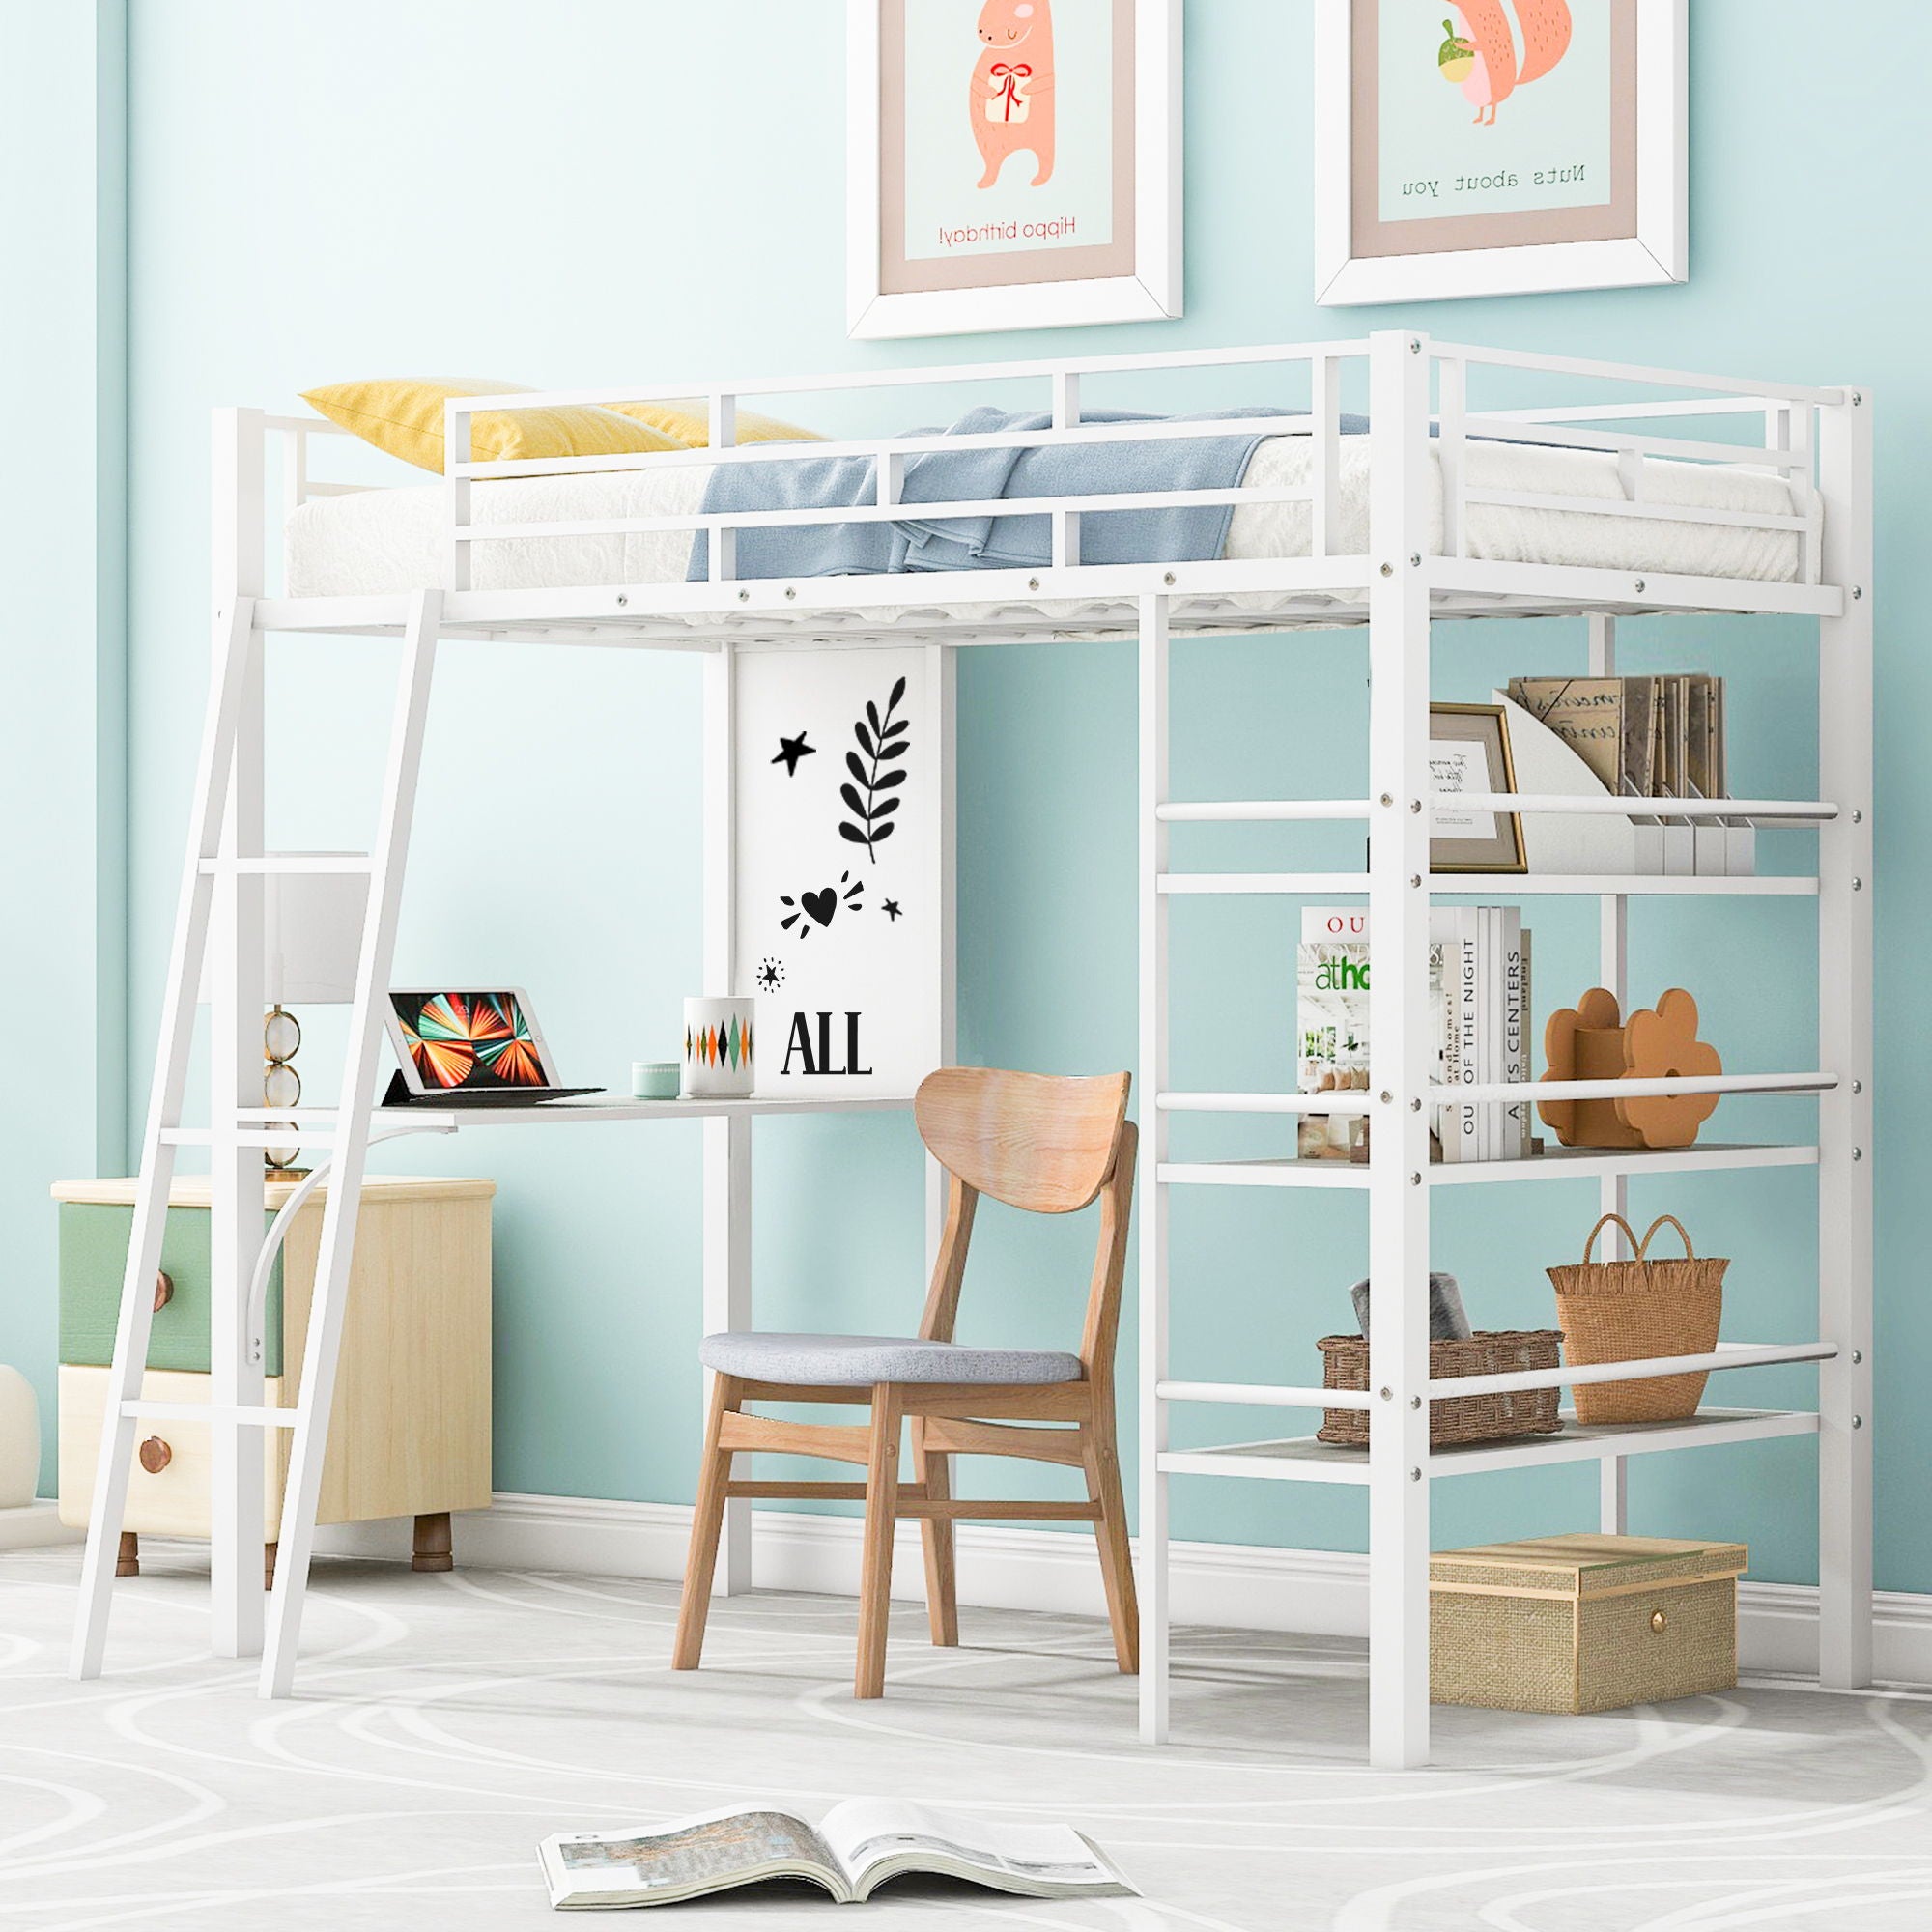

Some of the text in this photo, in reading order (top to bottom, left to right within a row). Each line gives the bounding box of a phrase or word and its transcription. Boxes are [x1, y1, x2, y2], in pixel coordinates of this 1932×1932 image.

[1327, 916, 1365, 933] OU
[1315, 955, 1370, 990] atho
[780, 1011, 873, 1075] ALL
[1463, 938, 1474, 1134] OU OF THE NIGHT
[1507, 952, 1520, 1119] ATS CENTERS
